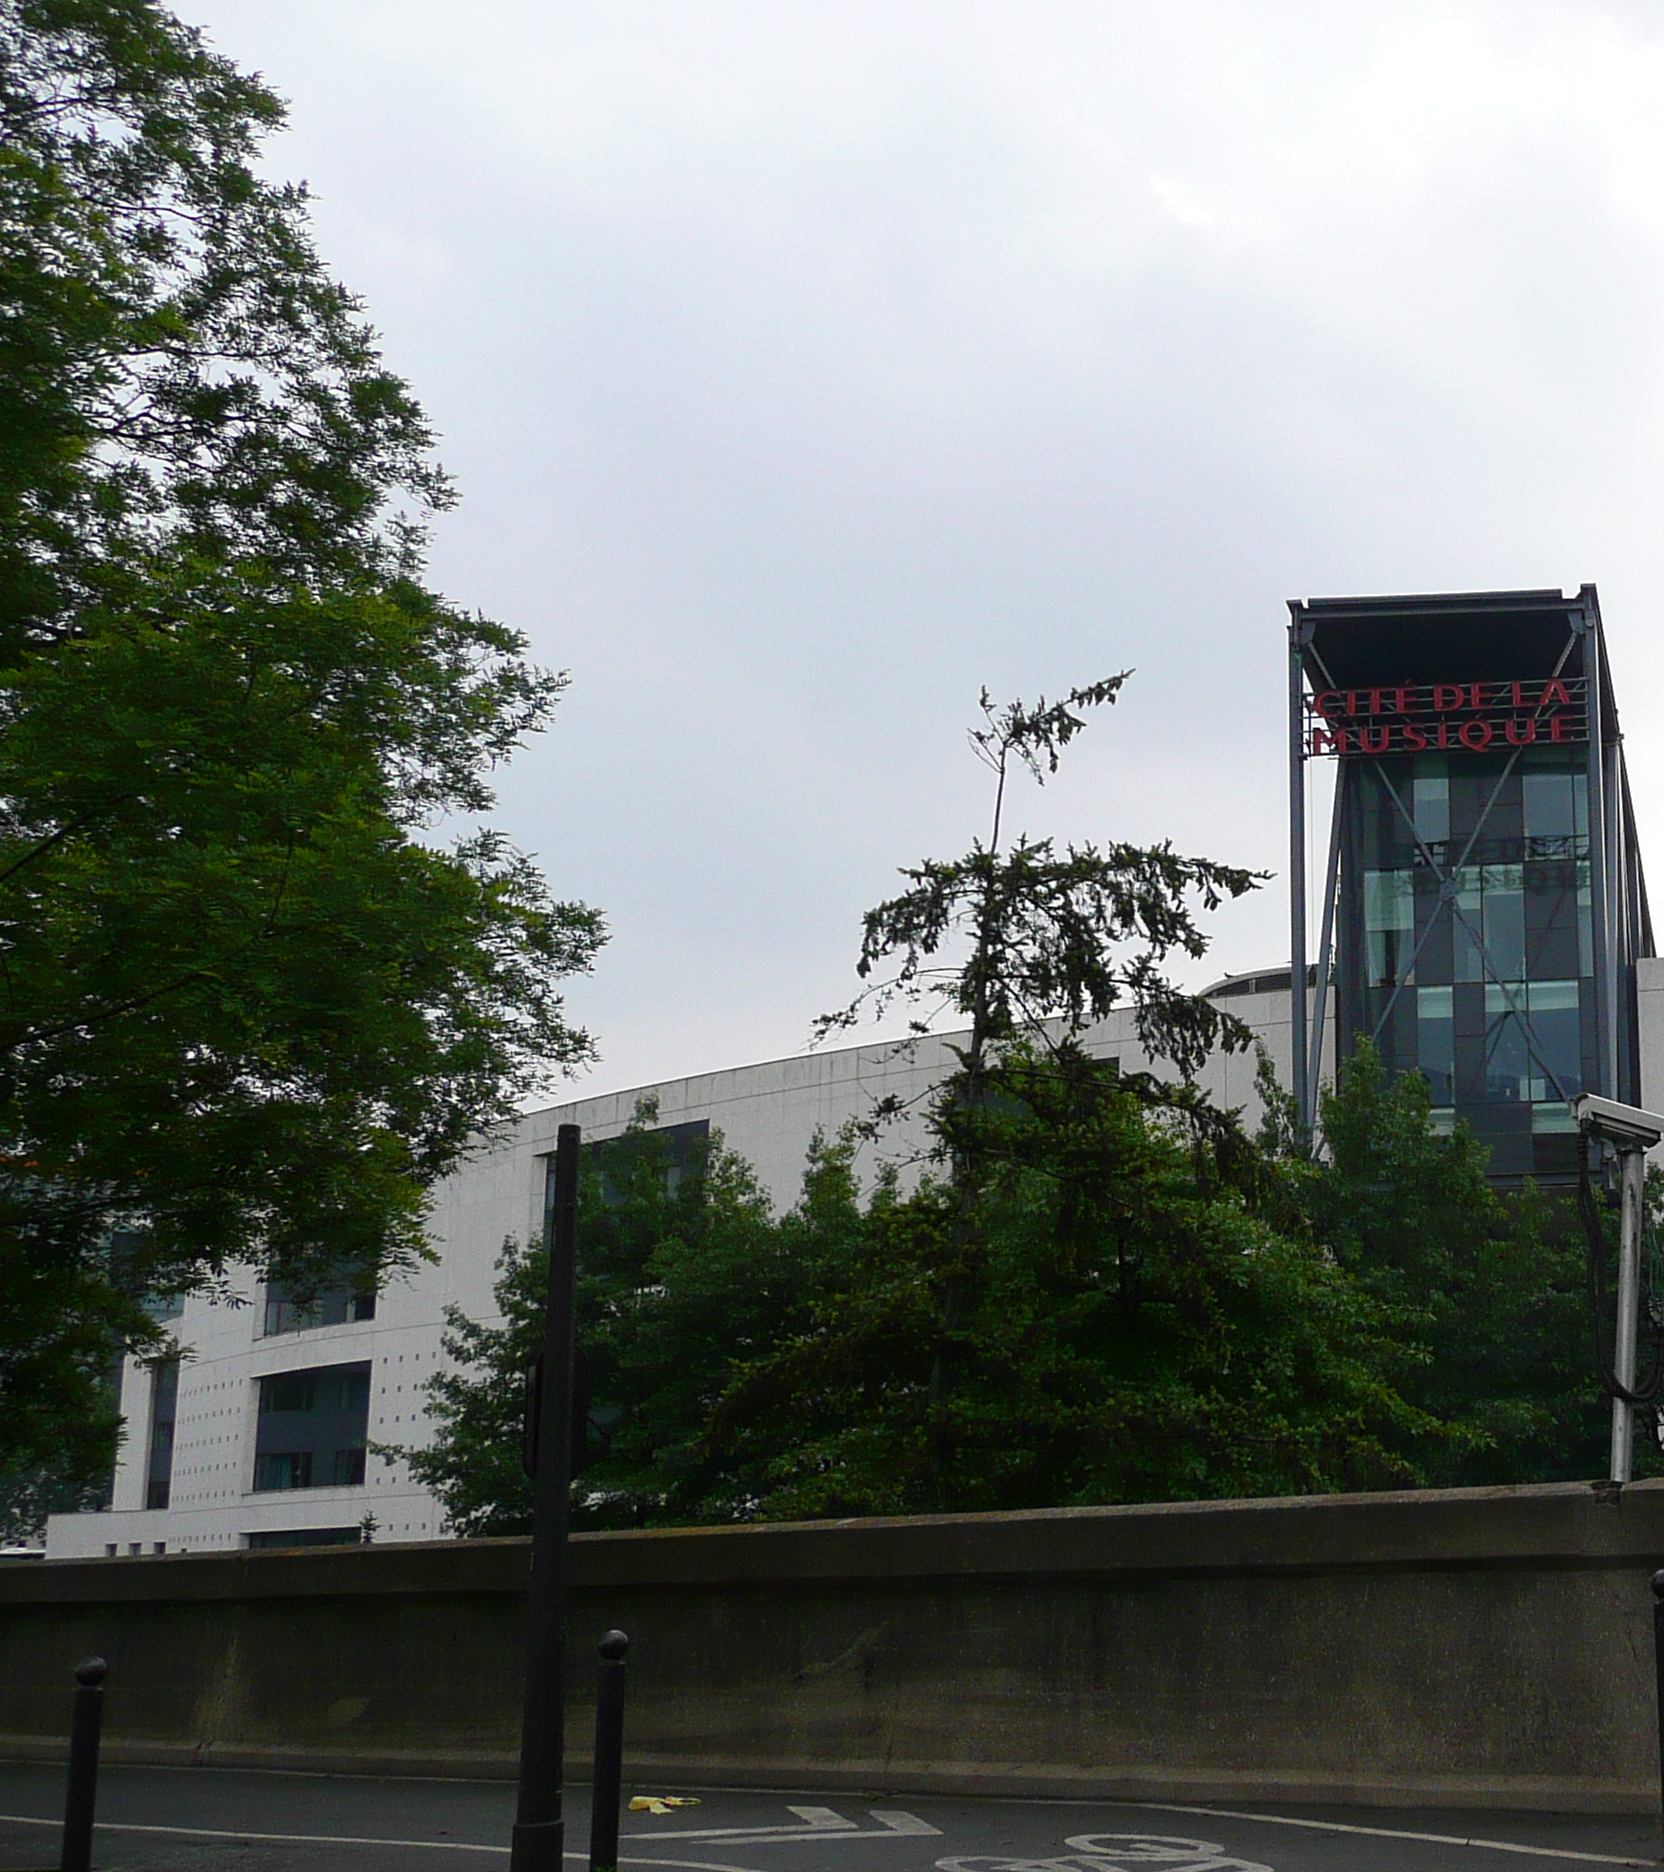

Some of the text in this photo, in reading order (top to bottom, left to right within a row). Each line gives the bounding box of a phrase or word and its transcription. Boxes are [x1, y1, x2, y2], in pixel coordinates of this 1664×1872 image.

[1434, 682, 1492, 711] DE
[1512, 678, 1570, 707] LA
[1313, 715, 1572, 754] MUSIQUE
